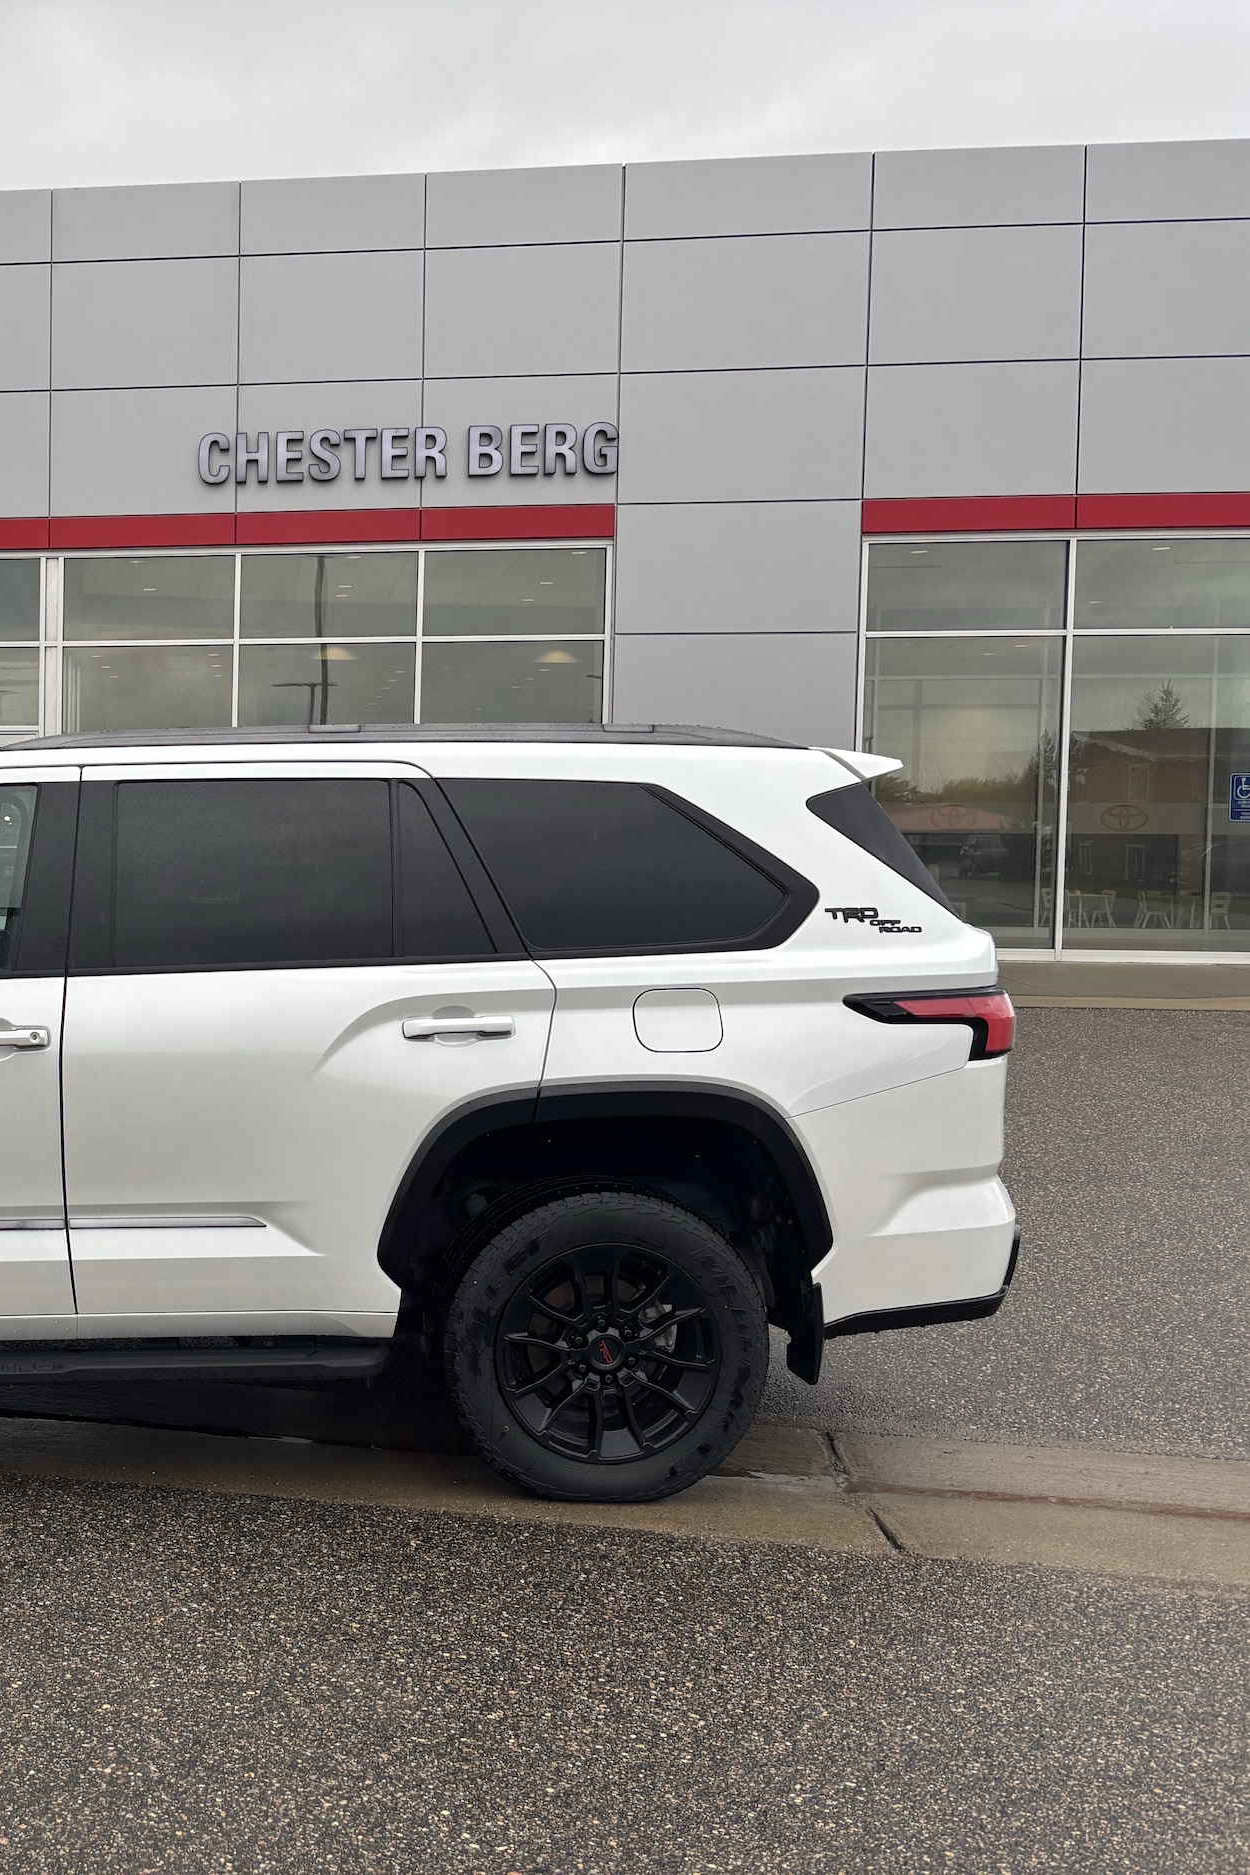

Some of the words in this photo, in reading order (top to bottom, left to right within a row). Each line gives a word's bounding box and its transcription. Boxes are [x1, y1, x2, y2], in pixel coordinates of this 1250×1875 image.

[198, 425, 448, 485] CHESTER
[467, 421, 619, 478] BERG
[824, 907, 879, 924] TRD
[869, 919, 901, 927] OFF
[878, 926, 923, 934] ROAD
[600, 1339, 614, 1364] TRD
